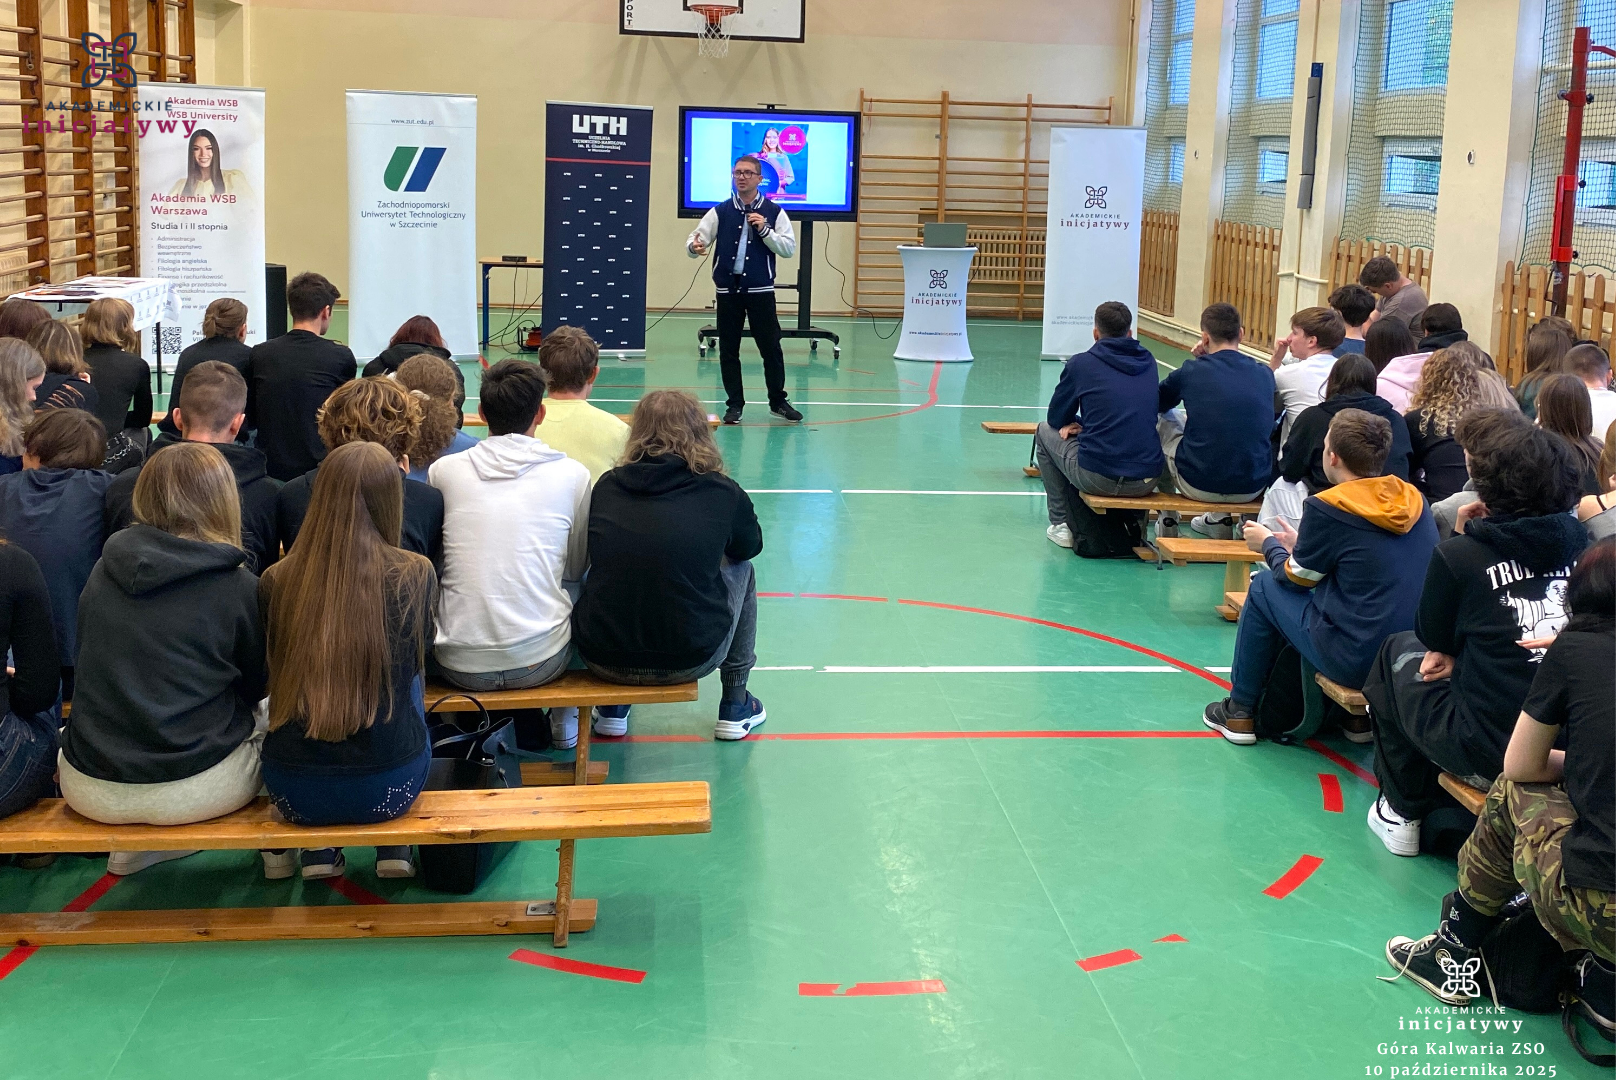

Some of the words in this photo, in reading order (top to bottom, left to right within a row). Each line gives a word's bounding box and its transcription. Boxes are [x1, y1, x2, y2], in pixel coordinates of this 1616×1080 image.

[167, 96, 215, 106] Akademia
[190, 112, 238, 122] University
[572, 114, 627, 135] UTH
[151, 193, 206, 203] Akademia
[210, 194, 237, 204] WSB
[377, 200, 450, 209] Zachodniopomorski
[151, 206, 208, 215] Warszawa
[361, 211, 406, 219] Uniwersytet
[409, 211, 466, 220] Technologiczny
[198, 223, 228, 231] stopnia
[1060, 219, 1130, 230] inicjatywy
[911, 297, 962, 306] inicjatywy
